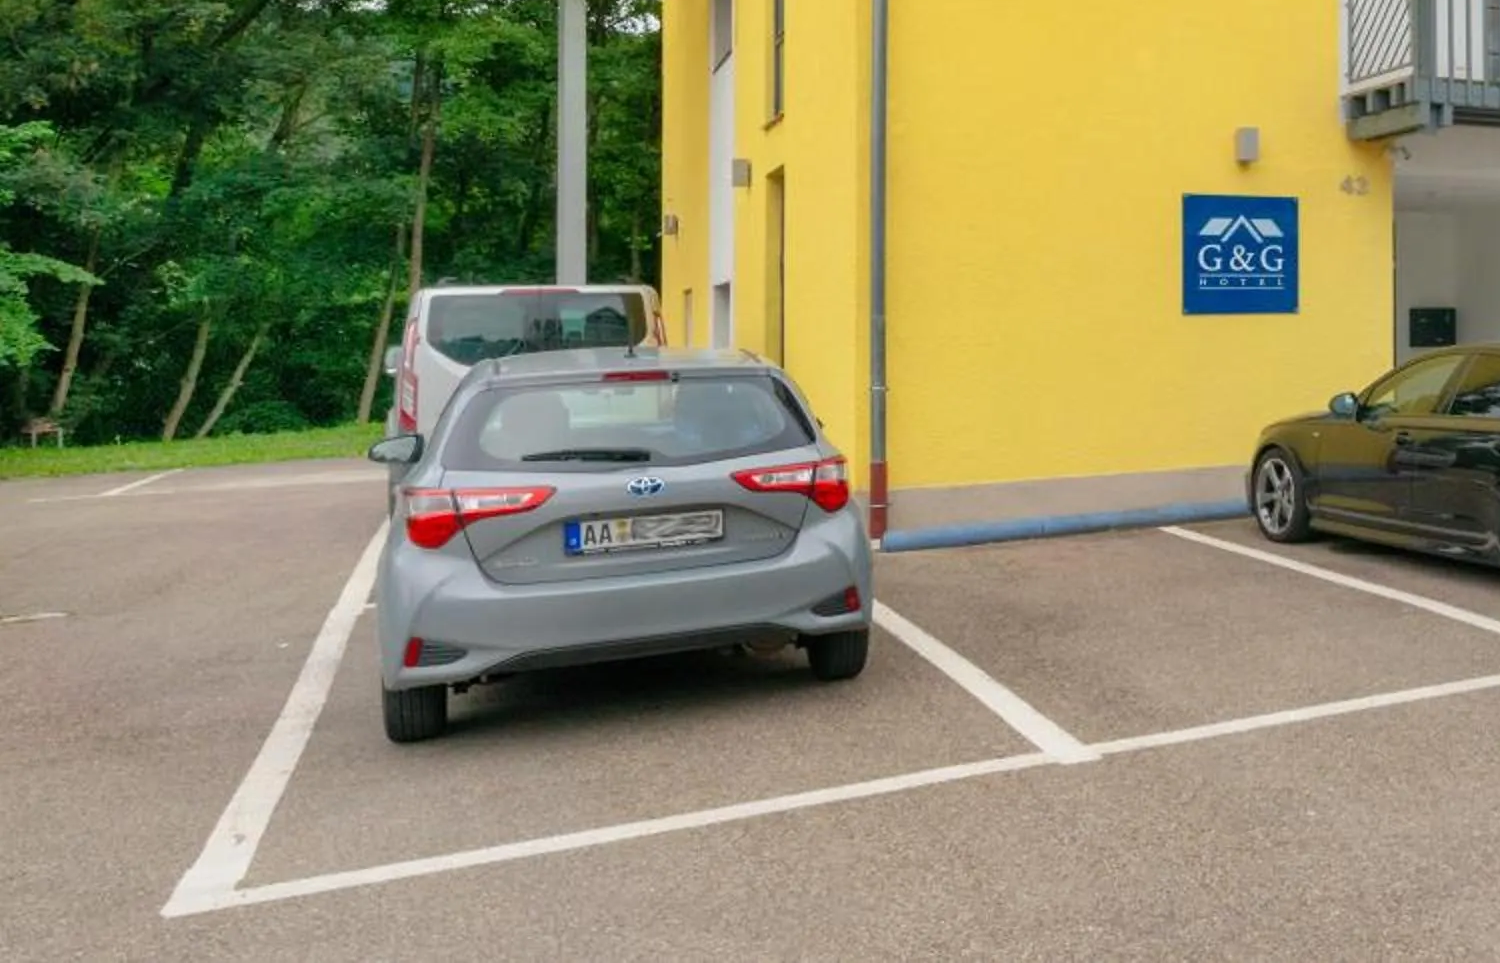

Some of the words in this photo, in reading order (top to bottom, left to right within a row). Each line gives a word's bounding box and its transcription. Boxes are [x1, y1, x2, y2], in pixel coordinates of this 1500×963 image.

[1198, 244, 1285, 272] G&G
[1199, 278, 1282, 286] HOTEL
[584, 523, 613, 545] AA
